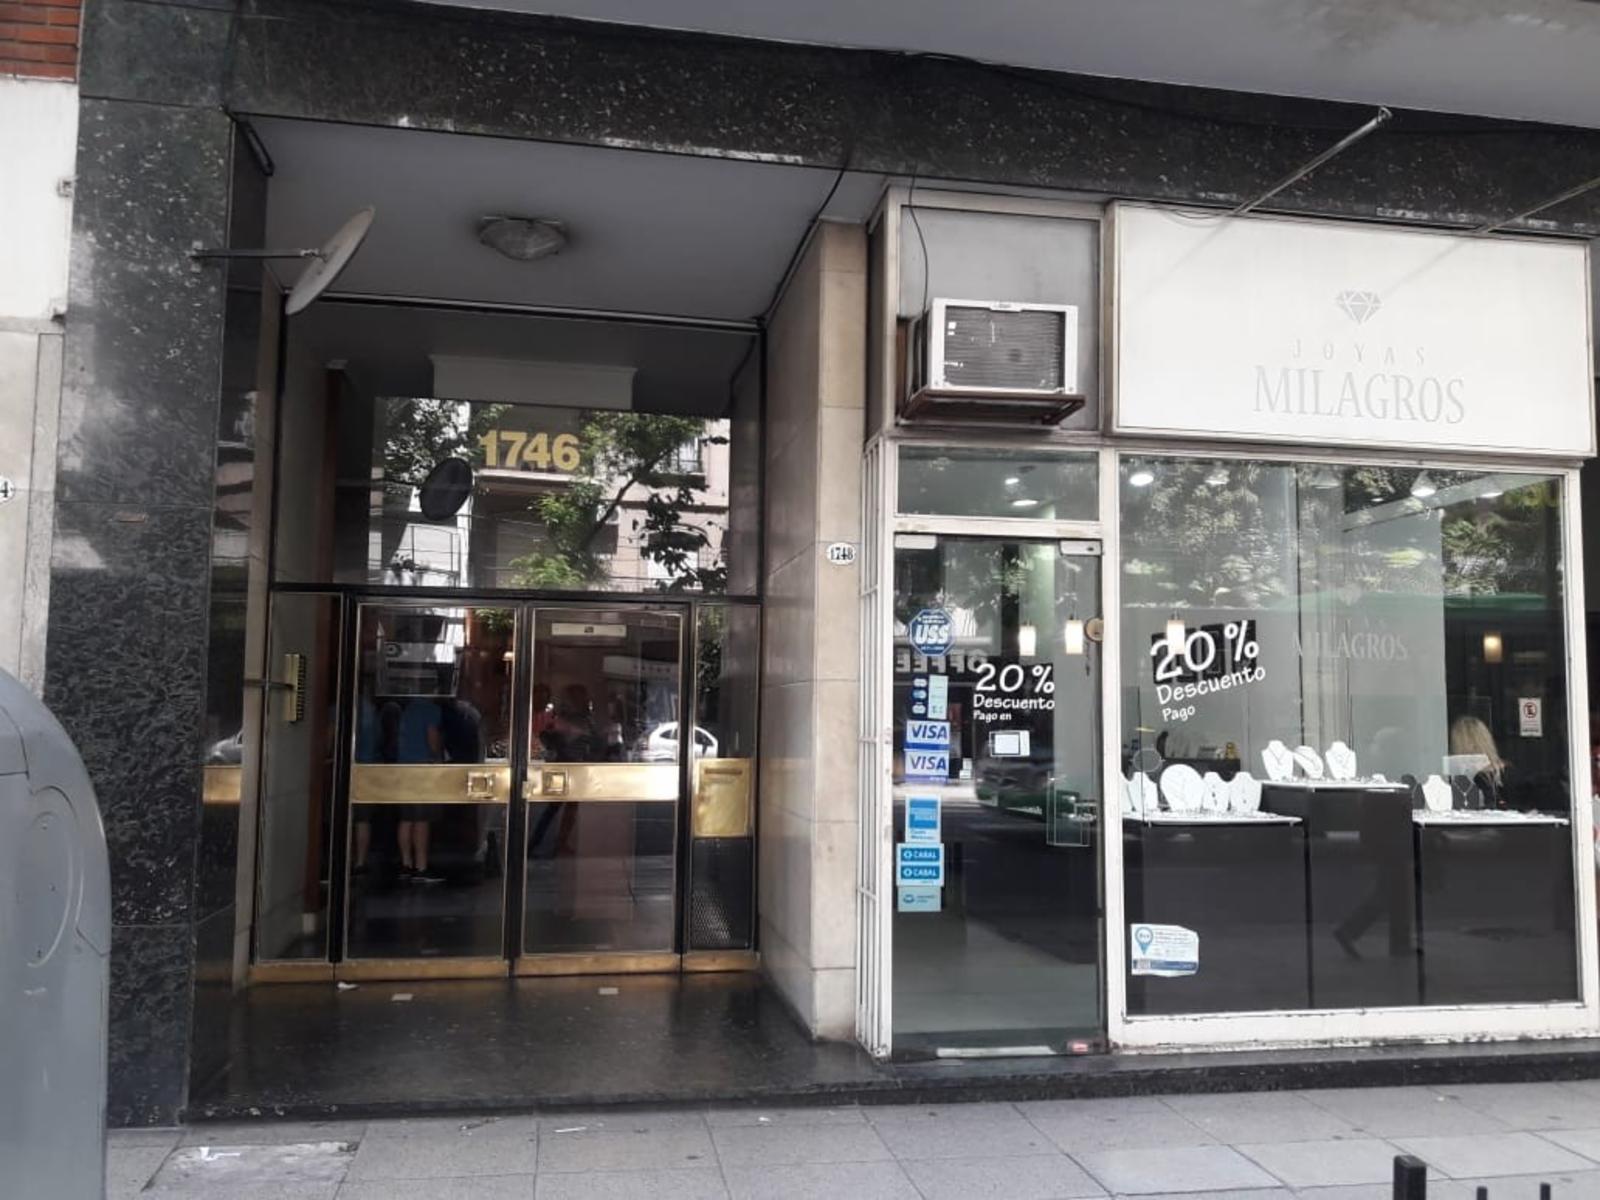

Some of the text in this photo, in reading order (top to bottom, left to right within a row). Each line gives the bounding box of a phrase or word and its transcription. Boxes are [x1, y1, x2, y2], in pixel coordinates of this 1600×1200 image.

[1253, 365, 1465, 424] MILAGROS
[478, 429, 580, 471] 1746
[830, 546, 854, 561] 1748
[915, 624, 950, 645] USS
[1156, 665, 1266, 705] Descuento
[973, 693, 1056, 710] Descuento
[973, 709, 1012, 723] Pago en
[1162, 704, 1196, 721] Pago
[911, 725, 948, 739] VISA
[910, 756, 947, 770] VISA
[913, 848, 938, 859] CABAL
[913, 866, 938, 877] CABAL
